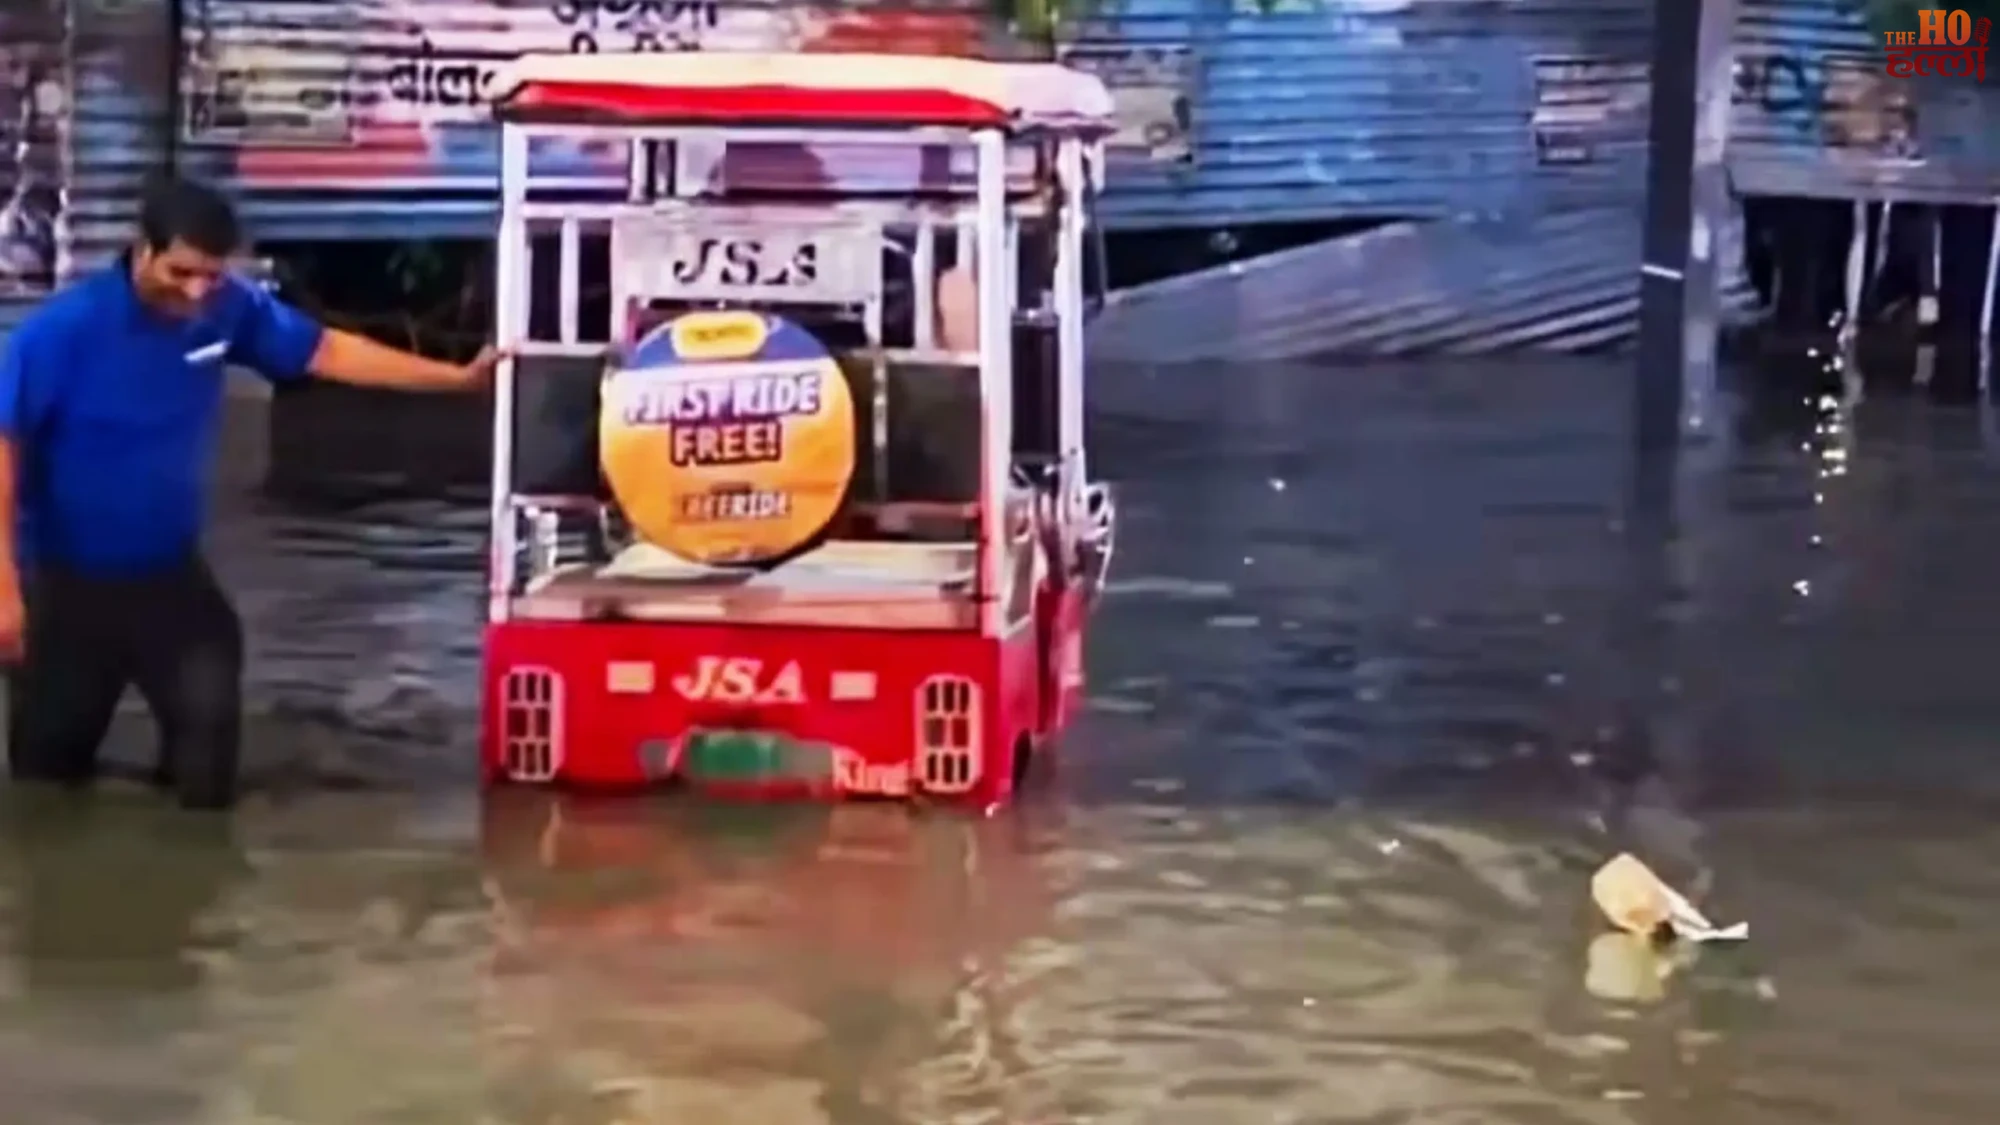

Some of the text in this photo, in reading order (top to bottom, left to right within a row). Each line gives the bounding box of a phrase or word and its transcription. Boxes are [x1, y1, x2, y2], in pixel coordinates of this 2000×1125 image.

[731, 372, 820, 418] RIDE
[671, 420, 780, 466] FREE!
[672, 657, 807, 703] JSA
